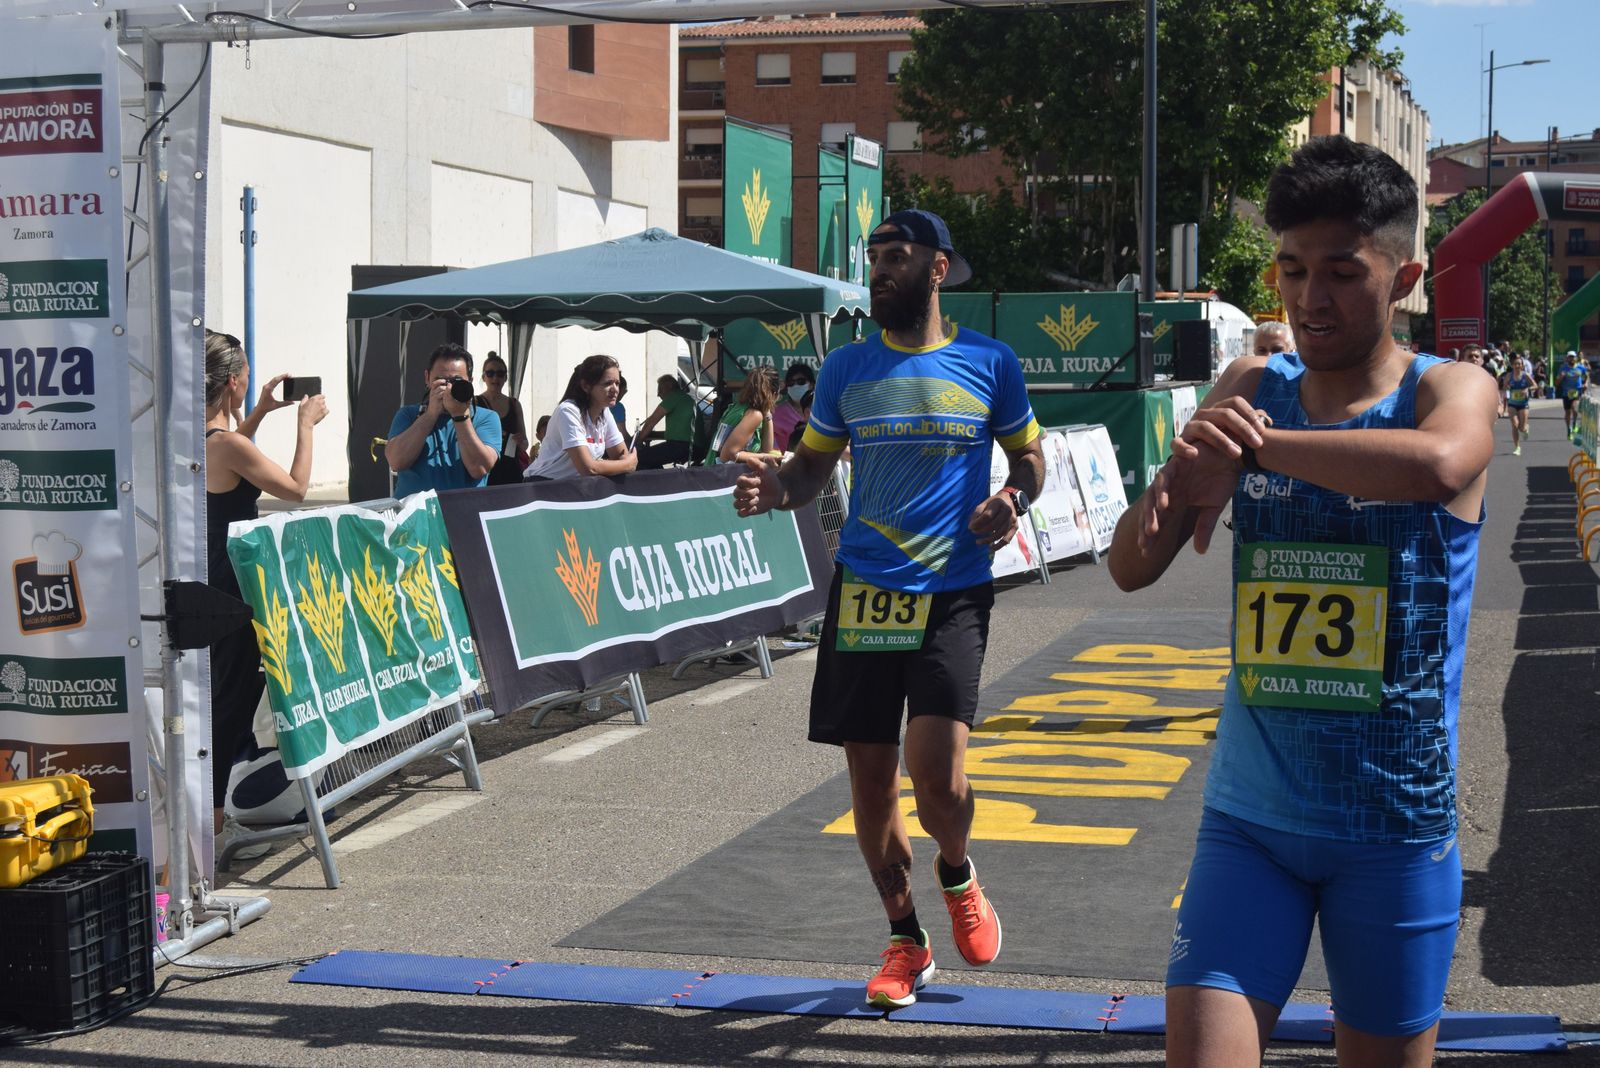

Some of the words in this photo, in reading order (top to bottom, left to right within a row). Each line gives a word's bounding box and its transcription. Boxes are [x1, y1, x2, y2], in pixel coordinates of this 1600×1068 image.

[72, 102, 94, 115] DE
[0, 118, 96, 143] AMORA
[13, 227, 54, 240] Zamora
[12, 281, 99, 298] FUNDACION
[13, 297, 41, 313] CAJA
[44, 297, 99, 312] RURAL
[1062, 357, 1125, 373] RURAL
[37, 419, 48, 431] de
[51, 419, 96, 431] Zamora
[21, 474, 107, 489] FUNDACION
[22, 490, 48, 505] CAJA
[51, 489, 108, 504] RURAL
[1270, 549, 1366, 568] FUNDACION
[609, 544, 684, 612] CAJA
[676, 528, 772, 598] RURAL
[1269, 566, 1304, 579] CAJA
[1308, 567, 1364, 581] RURAL
[20, 577, 74, 616] Susi
[852, 590, 917, 624] 193
[1249, 591, 1355, 658] 173
[862, 635, 884, 645] CAJA
[886, 635, 918, 645] RURAL
[28, 678, 117, 694] FUNDACION
[1260, 676, 1300, 693] CAJA
[1304, 679, 1370, 698] RURAL
[28, 692, 56, 708] CAJA
[60, 693, 118, 708] RURAL
